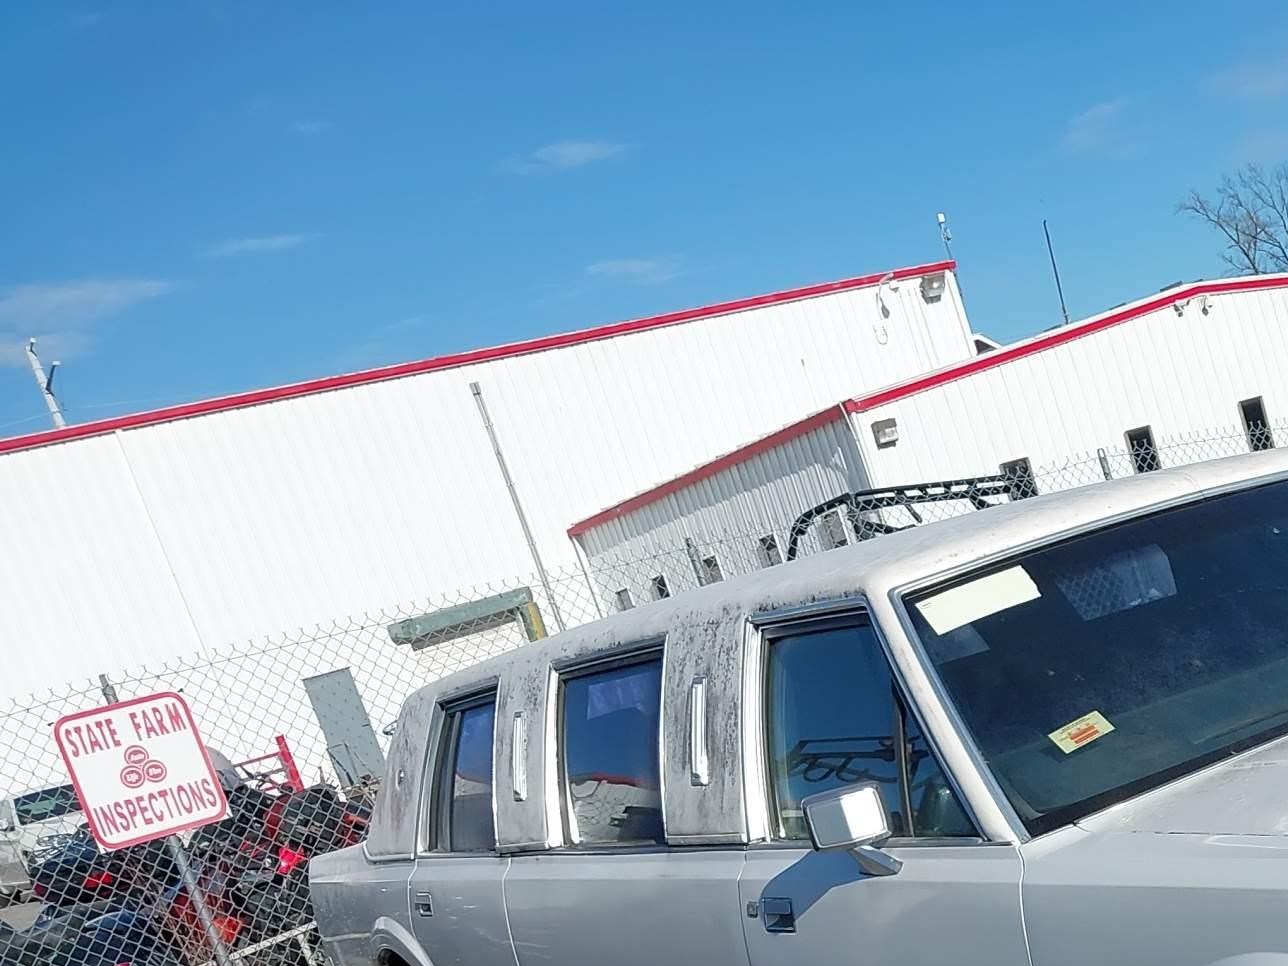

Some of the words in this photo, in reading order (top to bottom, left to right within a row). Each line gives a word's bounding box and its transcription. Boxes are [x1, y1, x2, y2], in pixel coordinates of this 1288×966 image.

[64, 718, 122, 758] STATE
[129, 702, 187, 741] FARM
[94, 778, 217, 837] INSPECTIONS
